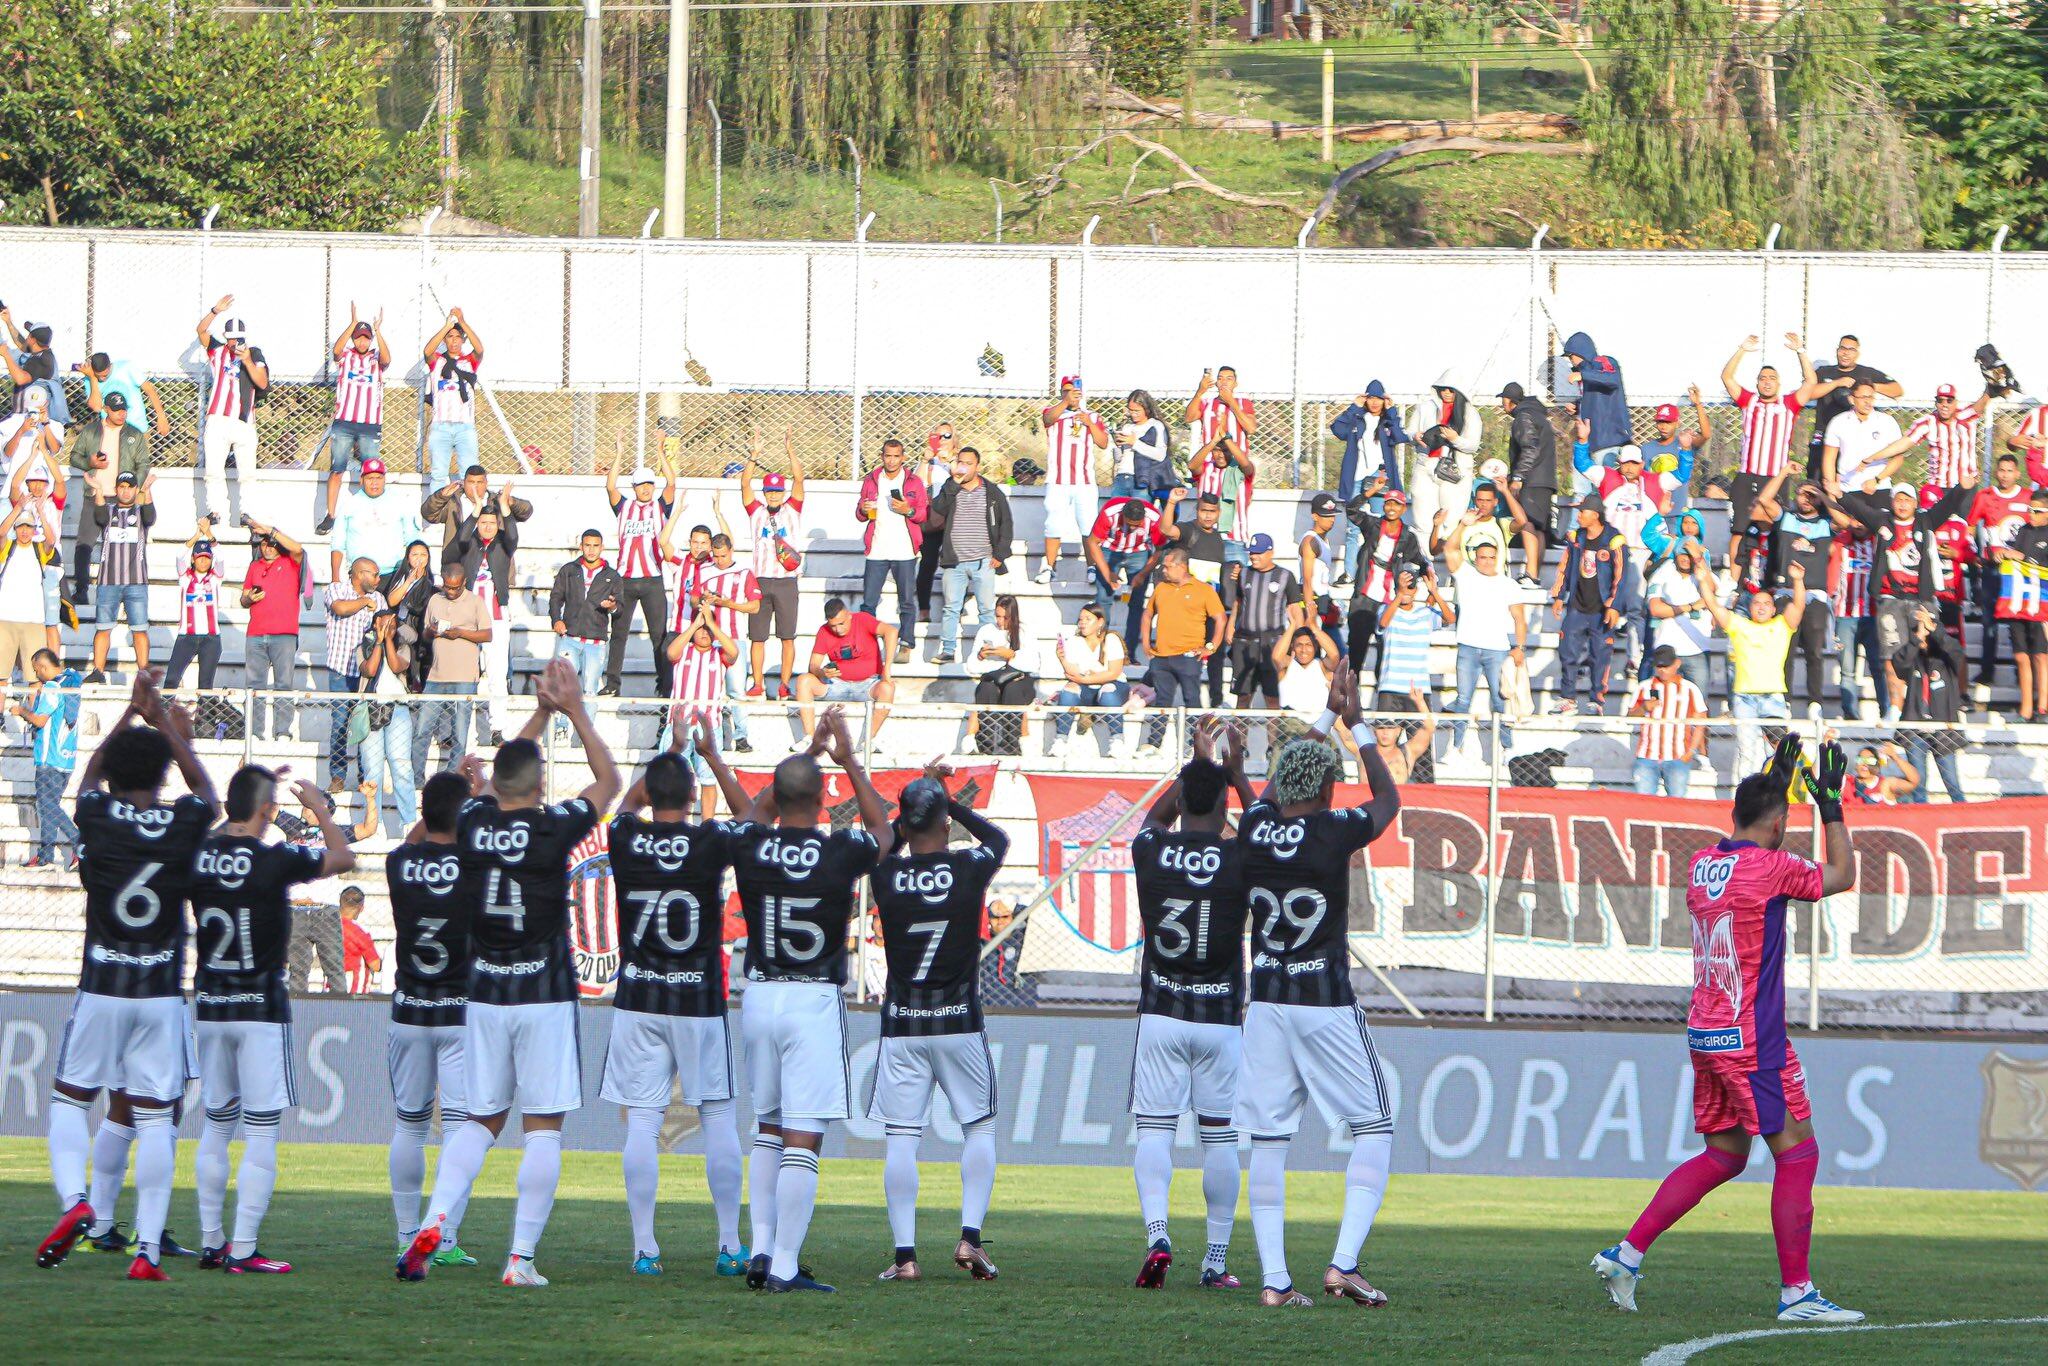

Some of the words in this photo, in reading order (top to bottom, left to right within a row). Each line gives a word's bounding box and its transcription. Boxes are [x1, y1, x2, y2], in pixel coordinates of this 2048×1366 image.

[198, 847, 253, 888] tigo
[474, 820, 530, 862] tigo
[633, 833, 690, 870] tigo
[758, 837, 822, 879] tigo
[1161, 845, 1221, 885] tigo
[1252, 819, 1305, 858] tigo
[116, 862, 165, 928] 6
[402, 855, 460, 895] tigo
[485, 868, 526, 932] 4
[895, 863, 953, 902] tigo
[1693, 855, 1738, 899] tigo
[1850, 827, 2027, 957] DE
[200, 907, 255, 970] 21
[411, 917, 449, 975] 3
[626, 889, 700, 951] 70
[764, 895, 825, 962] 15
[1154, 897, 1211, 960] 31
[1250, 886, 1327, 951] 29
[908, 920, 949, 981] 7
